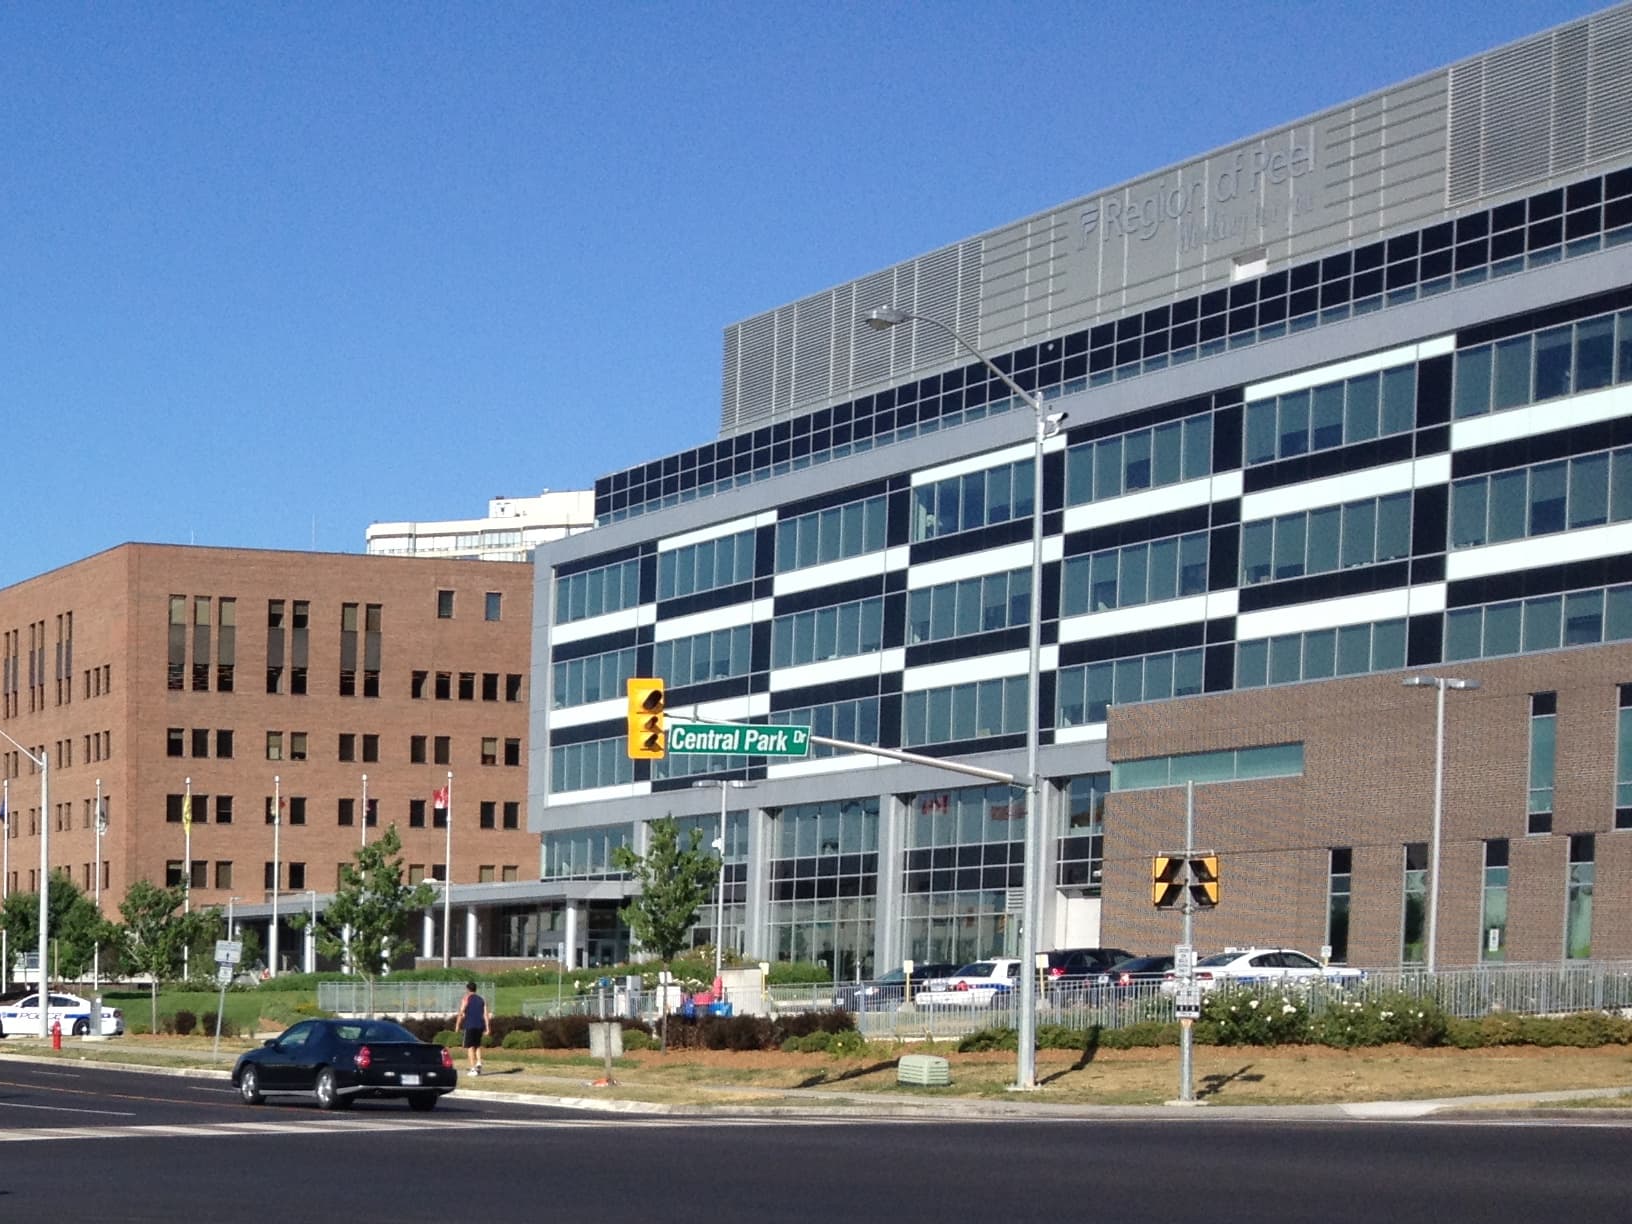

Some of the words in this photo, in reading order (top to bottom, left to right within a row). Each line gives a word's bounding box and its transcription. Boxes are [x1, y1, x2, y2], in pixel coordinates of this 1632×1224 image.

[1103, 182, 1206, 241] Region
[1217, 154, 1245, 203] of
[1249, 129, 1315, 193] Peel
[672, 727, 739, 750] Central
[744, 729, 788, 751] Park
[793, 730, 807, 744] Dr
